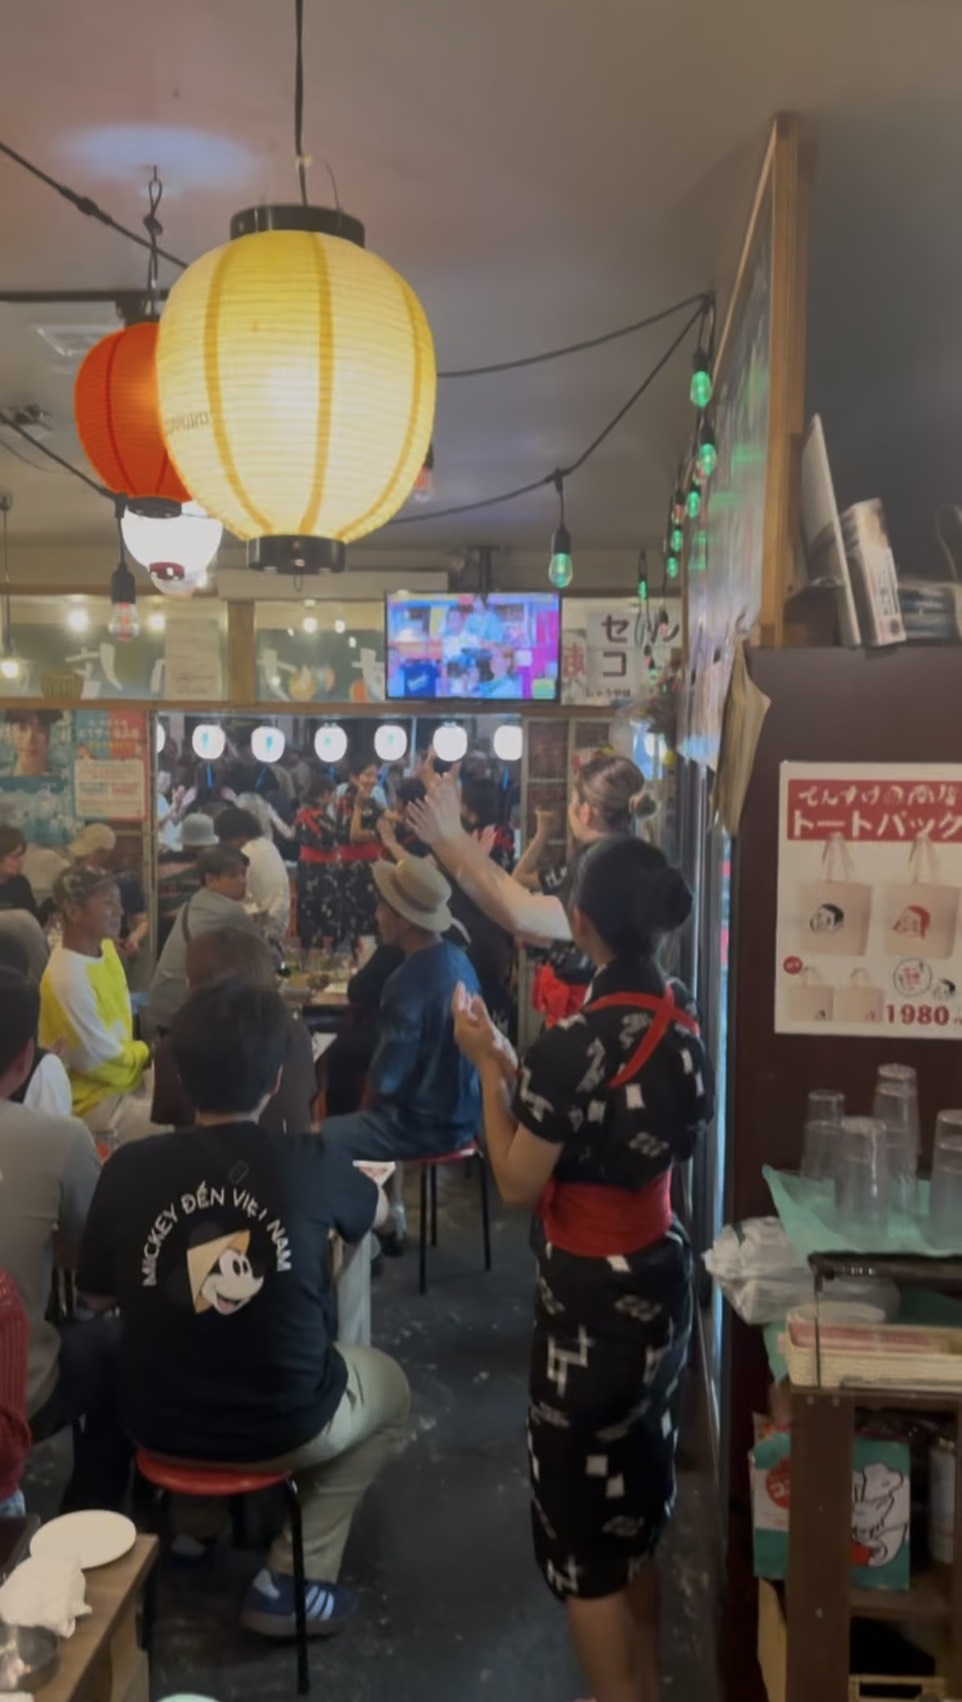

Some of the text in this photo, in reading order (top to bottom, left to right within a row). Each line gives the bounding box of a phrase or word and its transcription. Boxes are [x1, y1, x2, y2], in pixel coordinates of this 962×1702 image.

[886, 1004, 949, 1026] 1980
[141, 1203, 178, 1286] MICKEY
[266, 1219, 292, 1272] NAM
